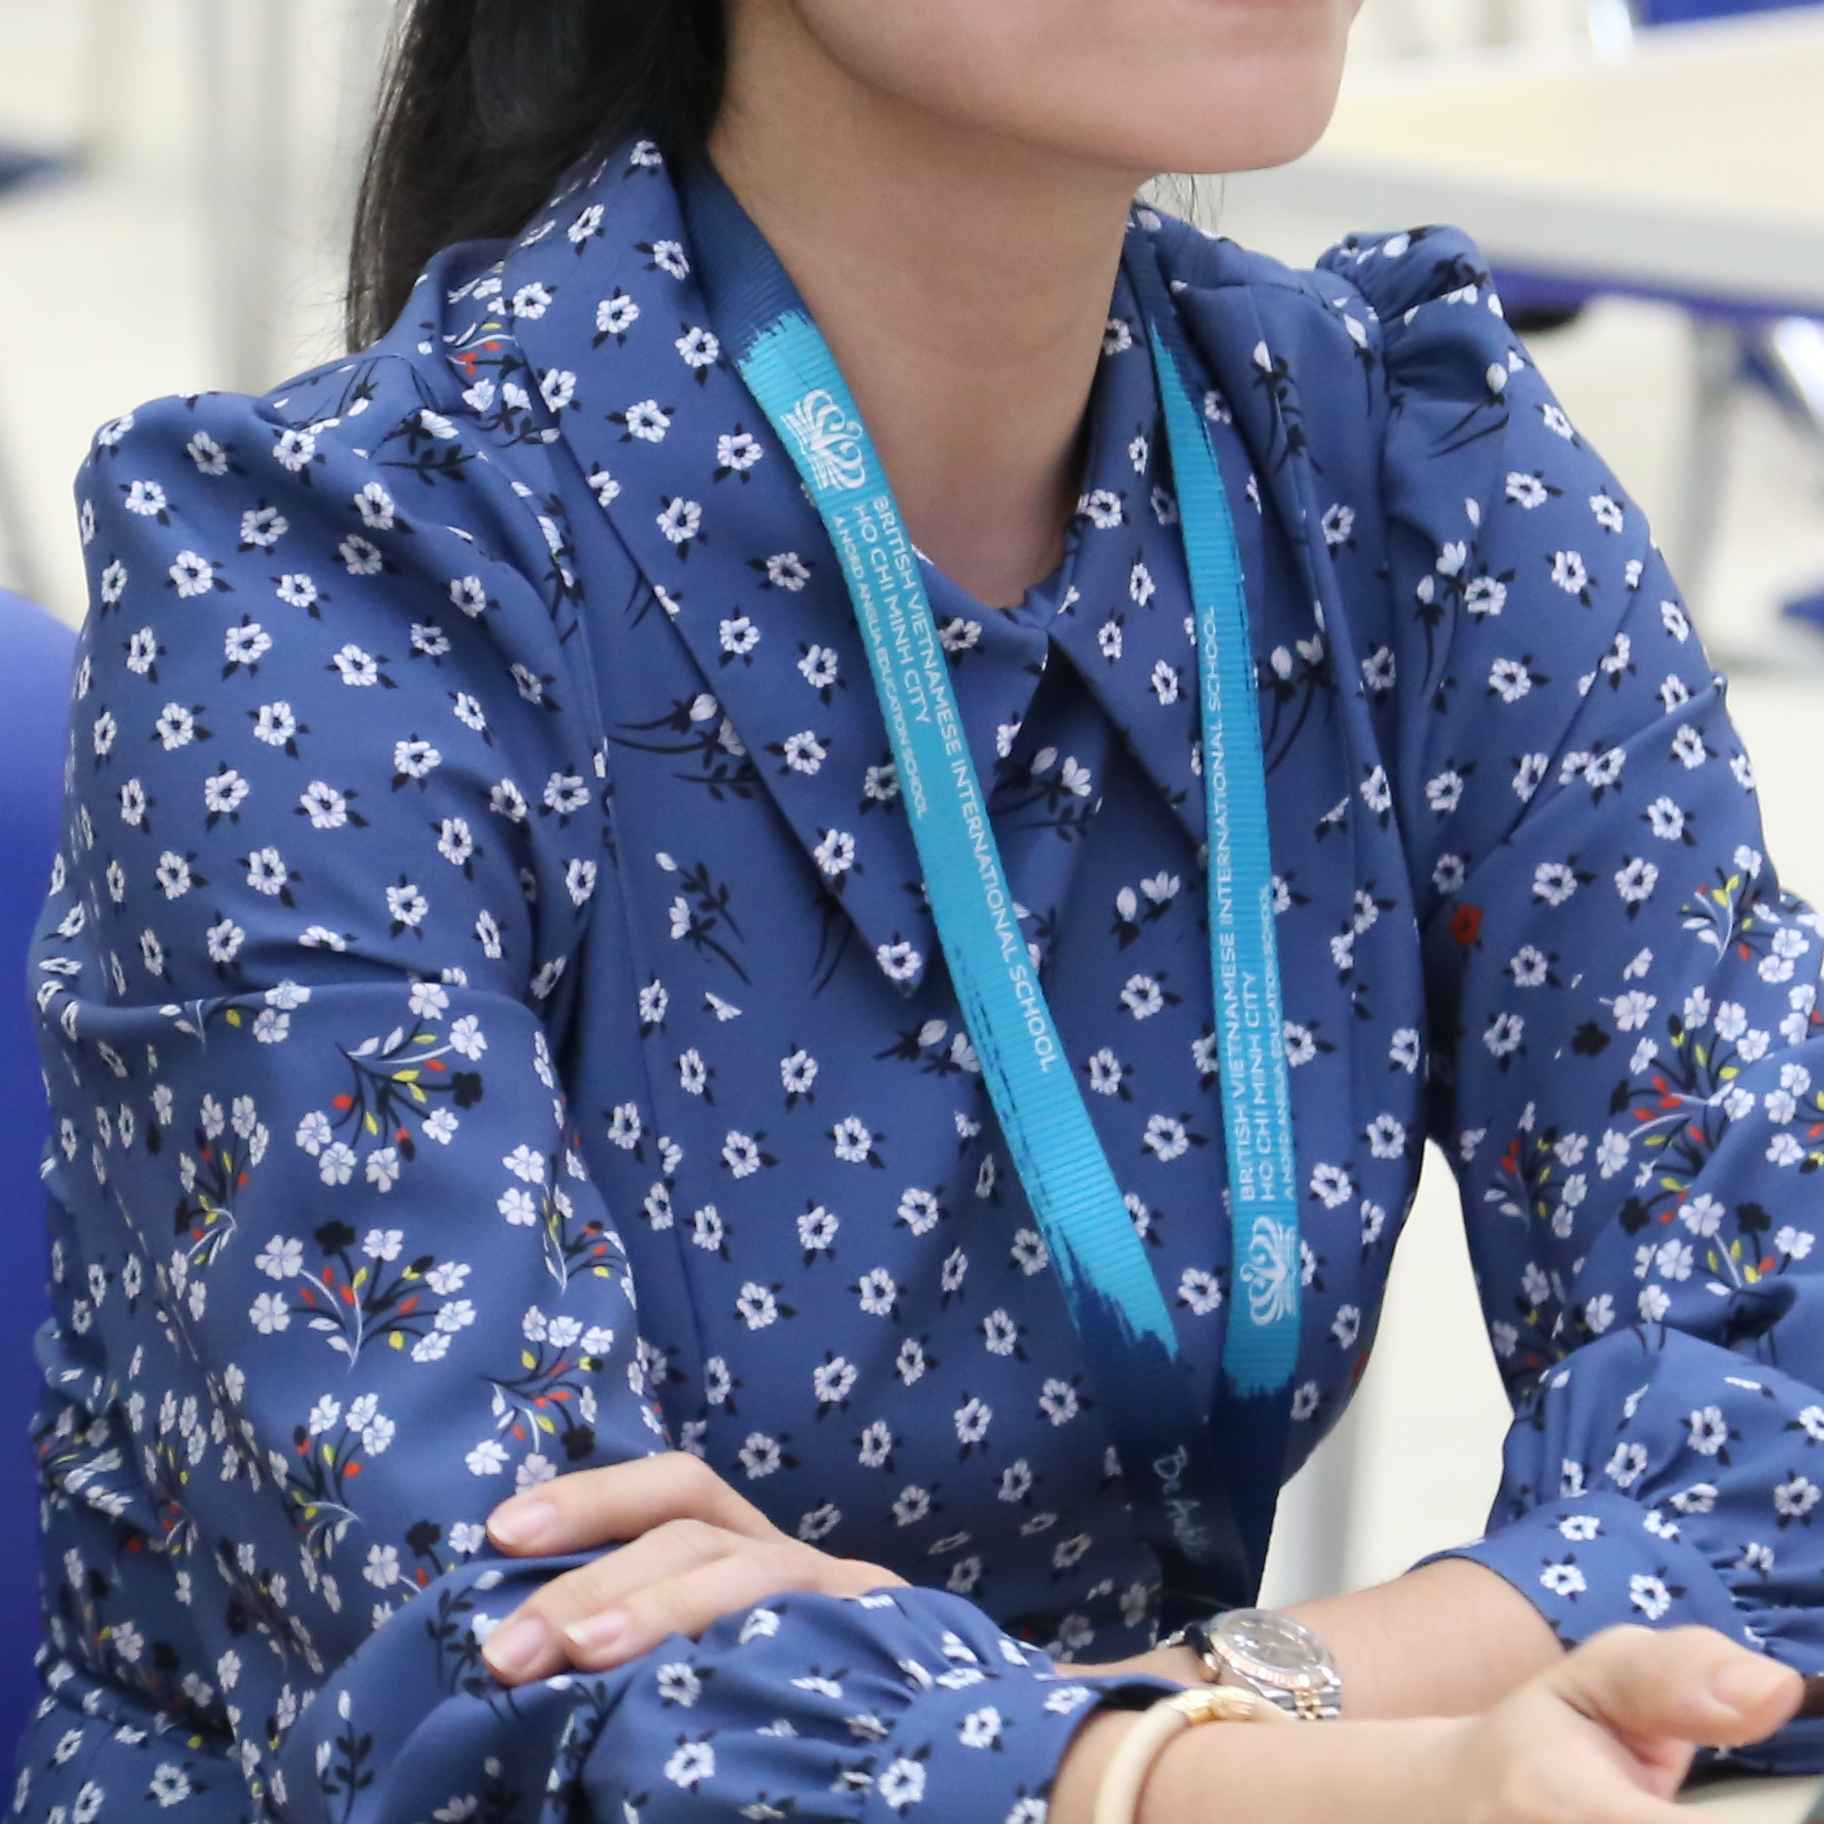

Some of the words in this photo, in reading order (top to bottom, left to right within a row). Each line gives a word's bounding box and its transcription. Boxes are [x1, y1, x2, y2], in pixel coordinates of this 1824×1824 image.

[852, 503, 878, 543] HO
[870, 546, 895, 592] CHI
[883, 593, 915, 665] MINH
[903, 669, 932, 723] CITY
[1203, 606, 1223, 712] SCHOOL
[832, 515, 847, 528] A
[874, 646, 914, 746] EDUCATION
[900, 746, 929, 820] SCHOOL
[873, 495, 917, 589] BRITISH
[907, 591, 963, 756] VIETNAMESE
[951, 758, 1020, 963] INTERNATIONAL
[1009, 963, 1059, 1073] SCHOOL
[1210, 719, 1236, 925] INTERNATIONAL
[1219, 931, 1247, 1099] VIETNAMESE
[1242, 971, 1260, 1028] CITY
[1248, 1033, 1270, 1106] MINH
[1234, 1103, 1255, 1202] BRITISH
[1254, 1112, 1273, 1156] CHI
[1257, 1160, 1277, 1202] HO
[1152, 1444, 1189, 1496] Be
